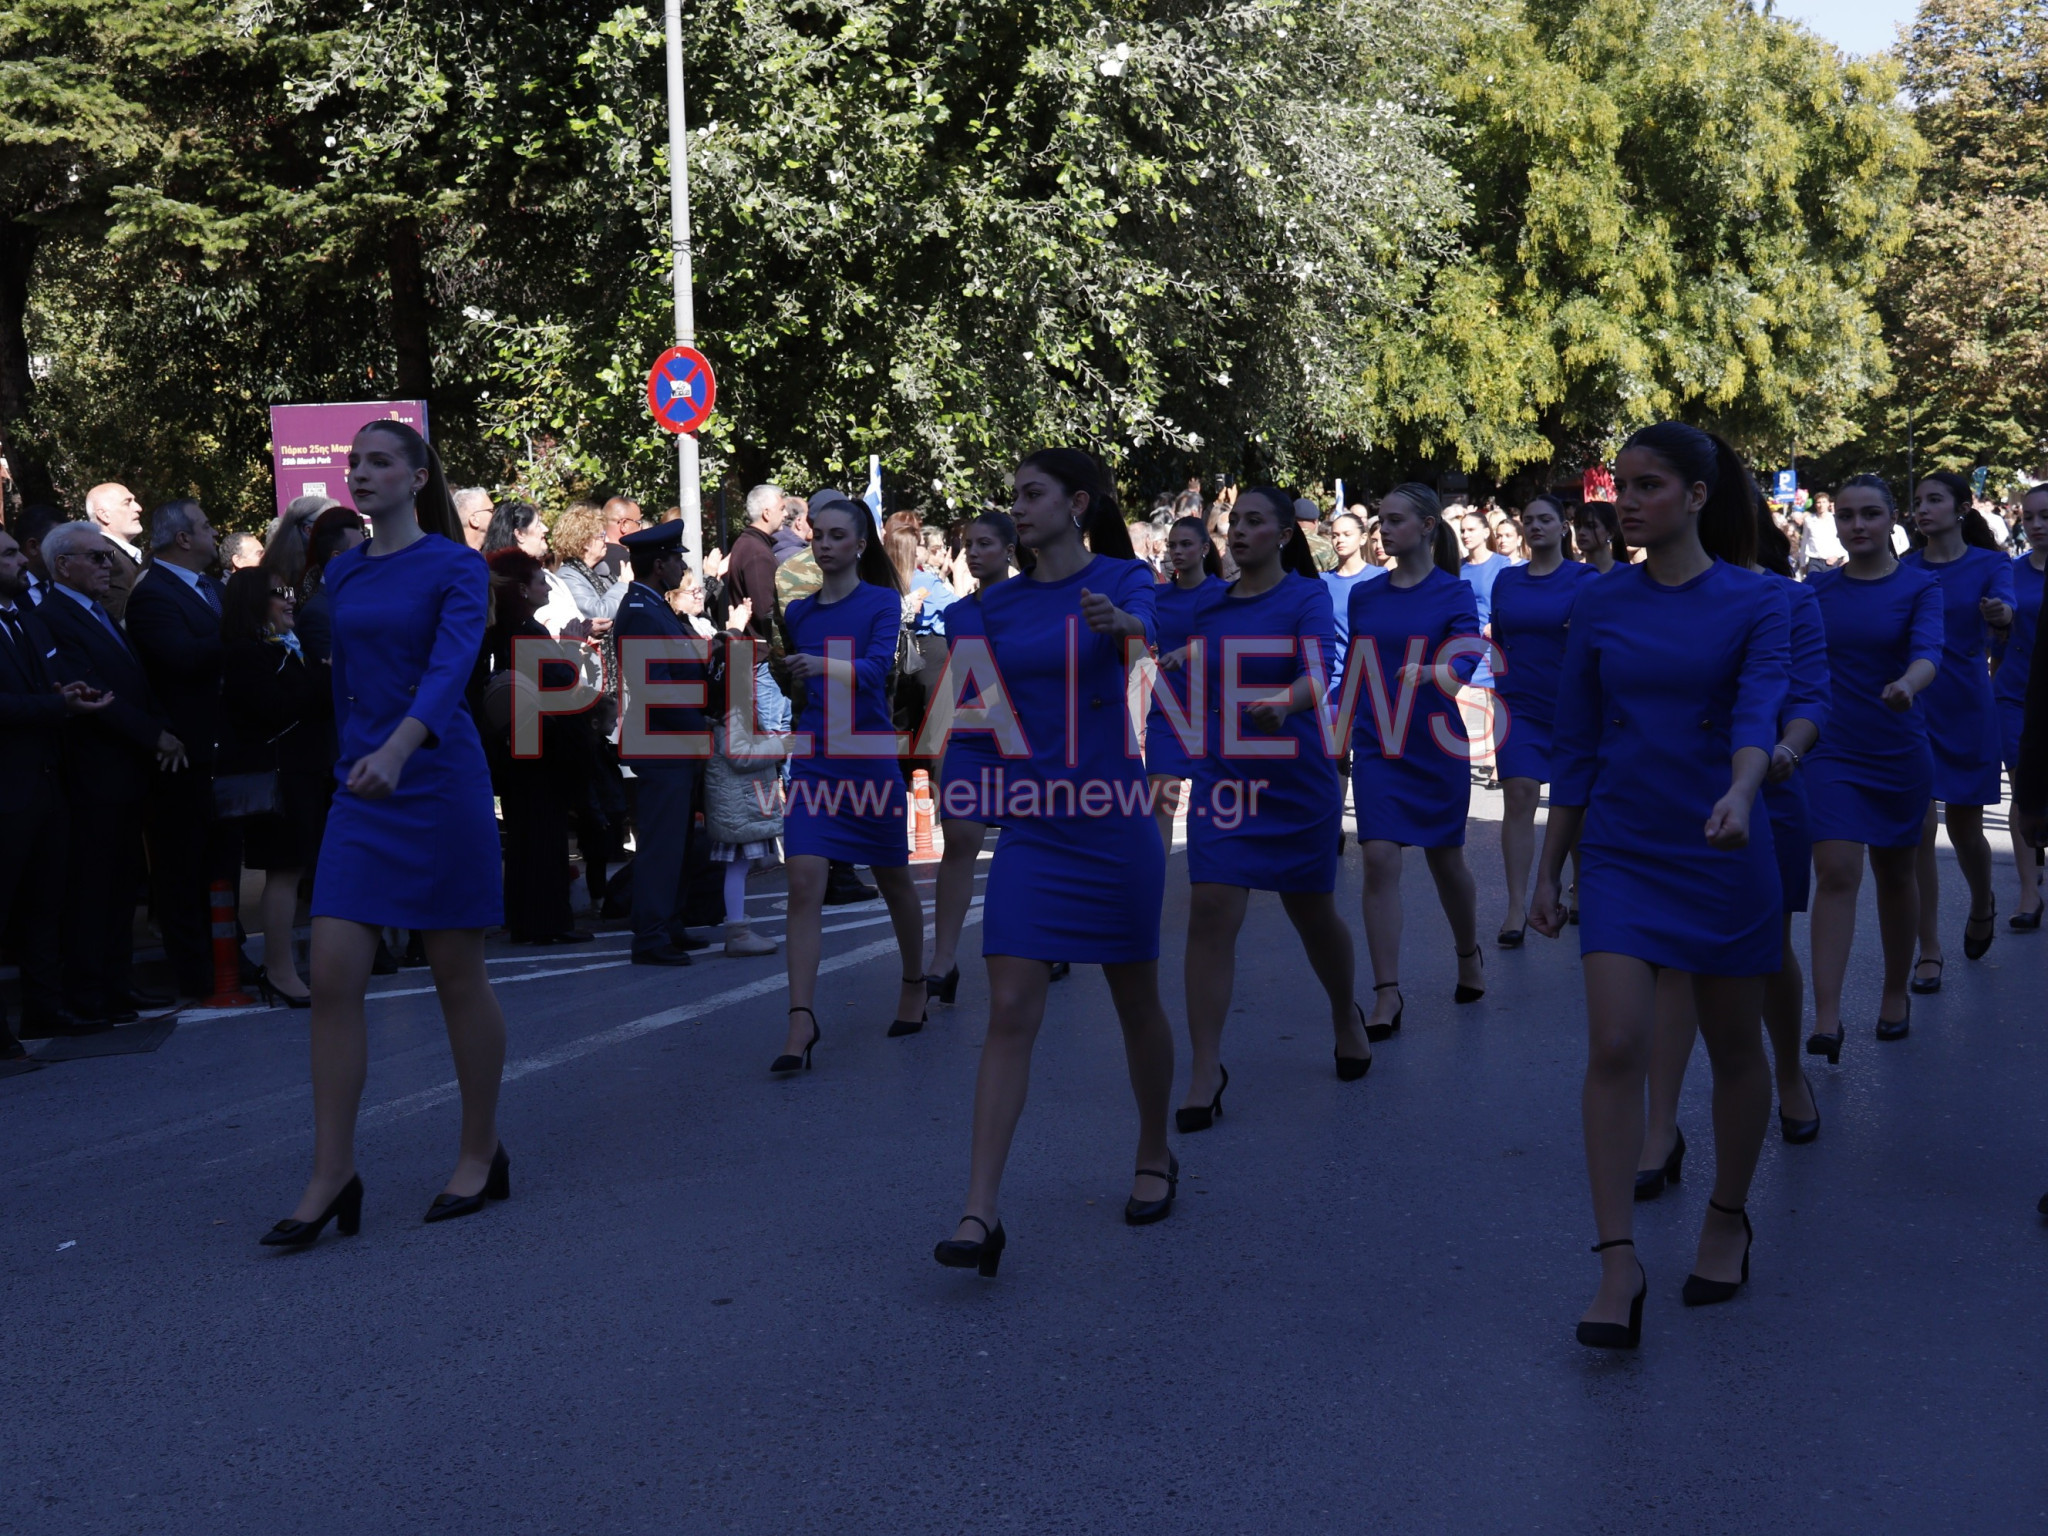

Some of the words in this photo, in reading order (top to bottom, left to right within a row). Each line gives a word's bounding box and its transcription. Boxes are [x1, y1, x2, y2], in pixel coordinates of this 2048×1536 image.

[281, 445, 308, 456] Πάρκο
[309, 444, 330, 455] 25ης
[330, 443, 352, 454] Μαρτ
[316, 456, 331, 464] Park
[1779, 473, 1791, 486] P
